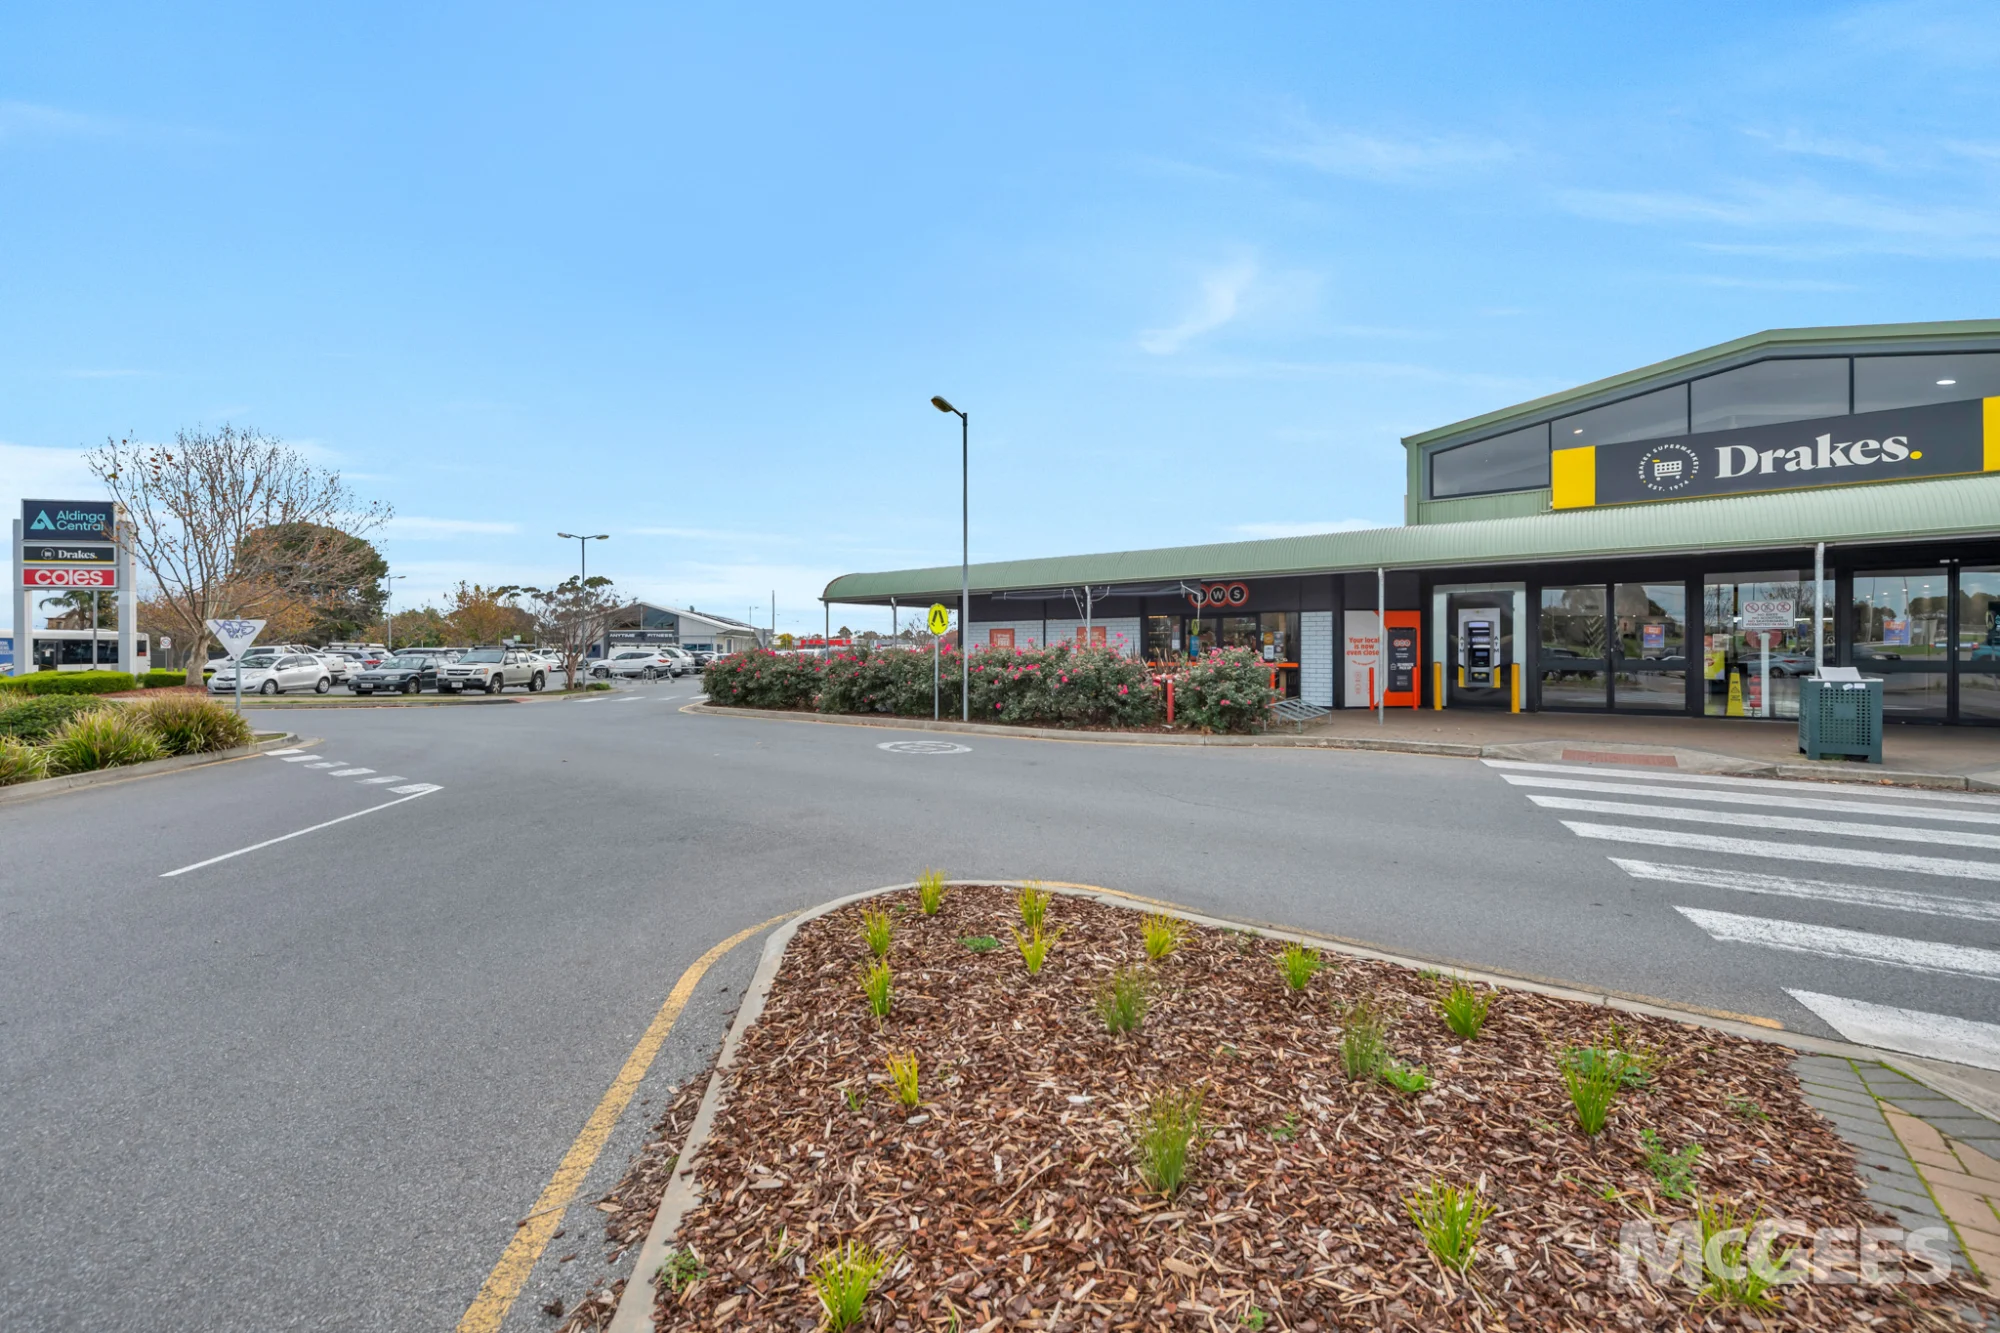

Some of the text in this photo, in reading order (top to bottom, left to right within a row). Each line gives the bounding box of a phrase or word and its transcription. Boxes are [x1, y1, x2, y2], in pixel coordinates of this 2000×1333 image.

[1714, 433, 1923, 479] Drakes.
[56, 510, 106, 523] Aldinga
[56, 520, 104, 531] Central
[34, 570, 104, 585] coles
